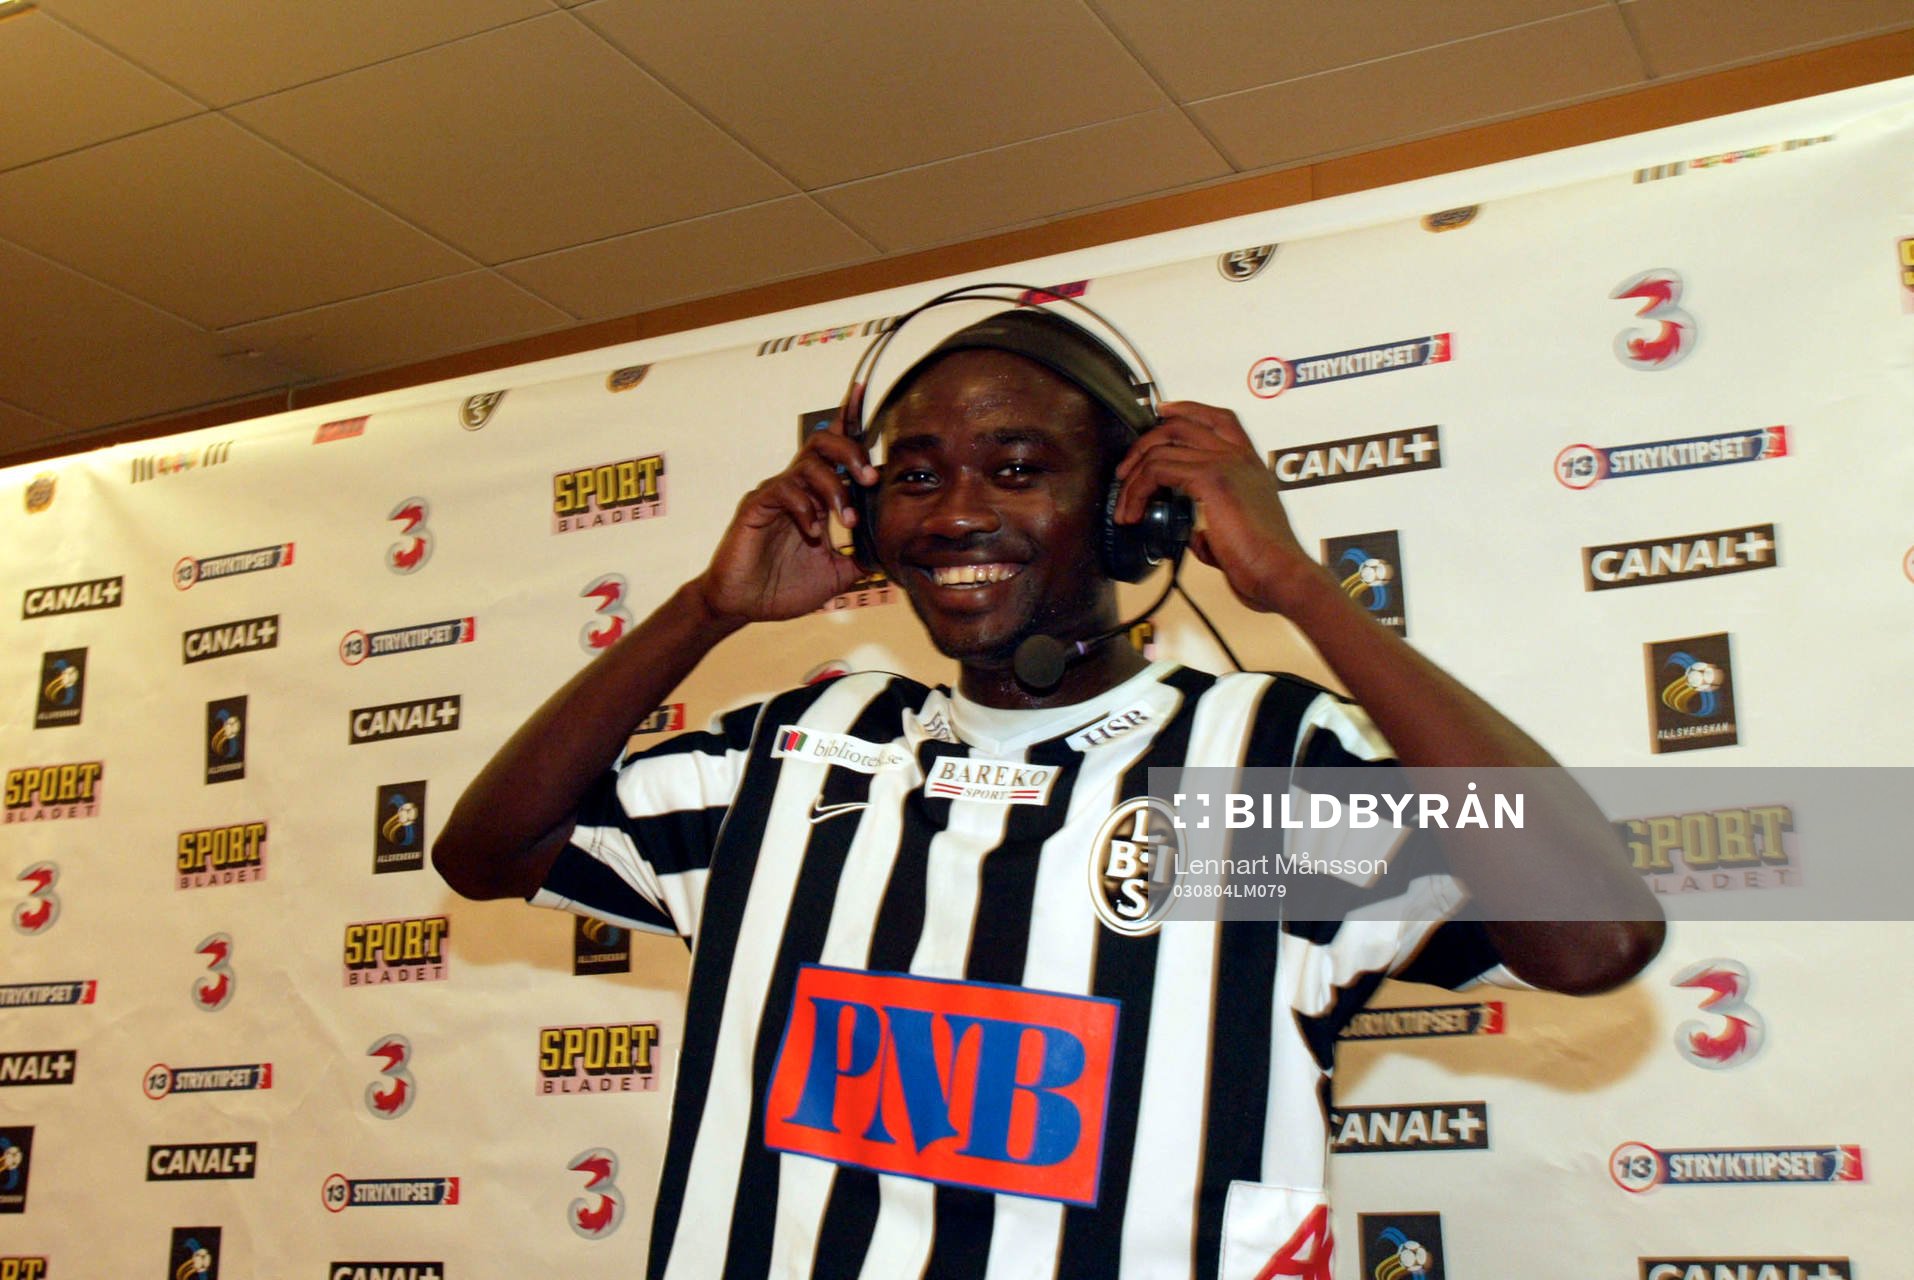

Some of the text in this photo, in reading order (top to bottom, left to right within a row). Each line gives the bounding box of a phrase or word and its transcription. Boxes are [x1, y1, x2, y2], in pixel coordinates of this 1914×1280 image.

[1254, 369, 1283, 390] 13
[1275, 433, 1434, 483] CANAL+
[1561, 455, 1593, 479] 13
[553, 455, 664, 517] SPORT
[559, 503, 662, 532] BLADET
[1590, 531, 1772, 582] CANAL+
[177, 565, 195, 584] 13
[24, 579, 121, 614] CANAL+
[834, 589, 889, 609] DET
[185, 618, 278, 659] CANAL+
[343, 638, 364, 657] 13
[352, 700, 458, 739] CANAL+
[1081, 709, 1150, 746] HSR
[3, 761, 103, 809] SPORT
[939, 762, 1048, 787] BAREKO
[965, 787, 1009, 800] SPORT
[6, 804, 95, 824] BLADET
[177, 822, 267, 874] SPORT
[180, 868, 262, 889] BLADET
[1653, 868, 1790, 893] LADET
[344, 917, 448, 970] SPORT
[349, 966, 444, 986] BLADET
[539, 1024, 660, 1077] SPORT
[0, 1054, 73, 1080] NAL+
[149, 1074, 166, 1091] 13
[543, 1076, 653, 1095] BLADET
[781, 996, 1086, 1168] PNB
[151, 1146, 254, 1176] CANAL+
[1617, 1155, 1654, 1179] 13
[326, 1185, 345, 1202] 13
